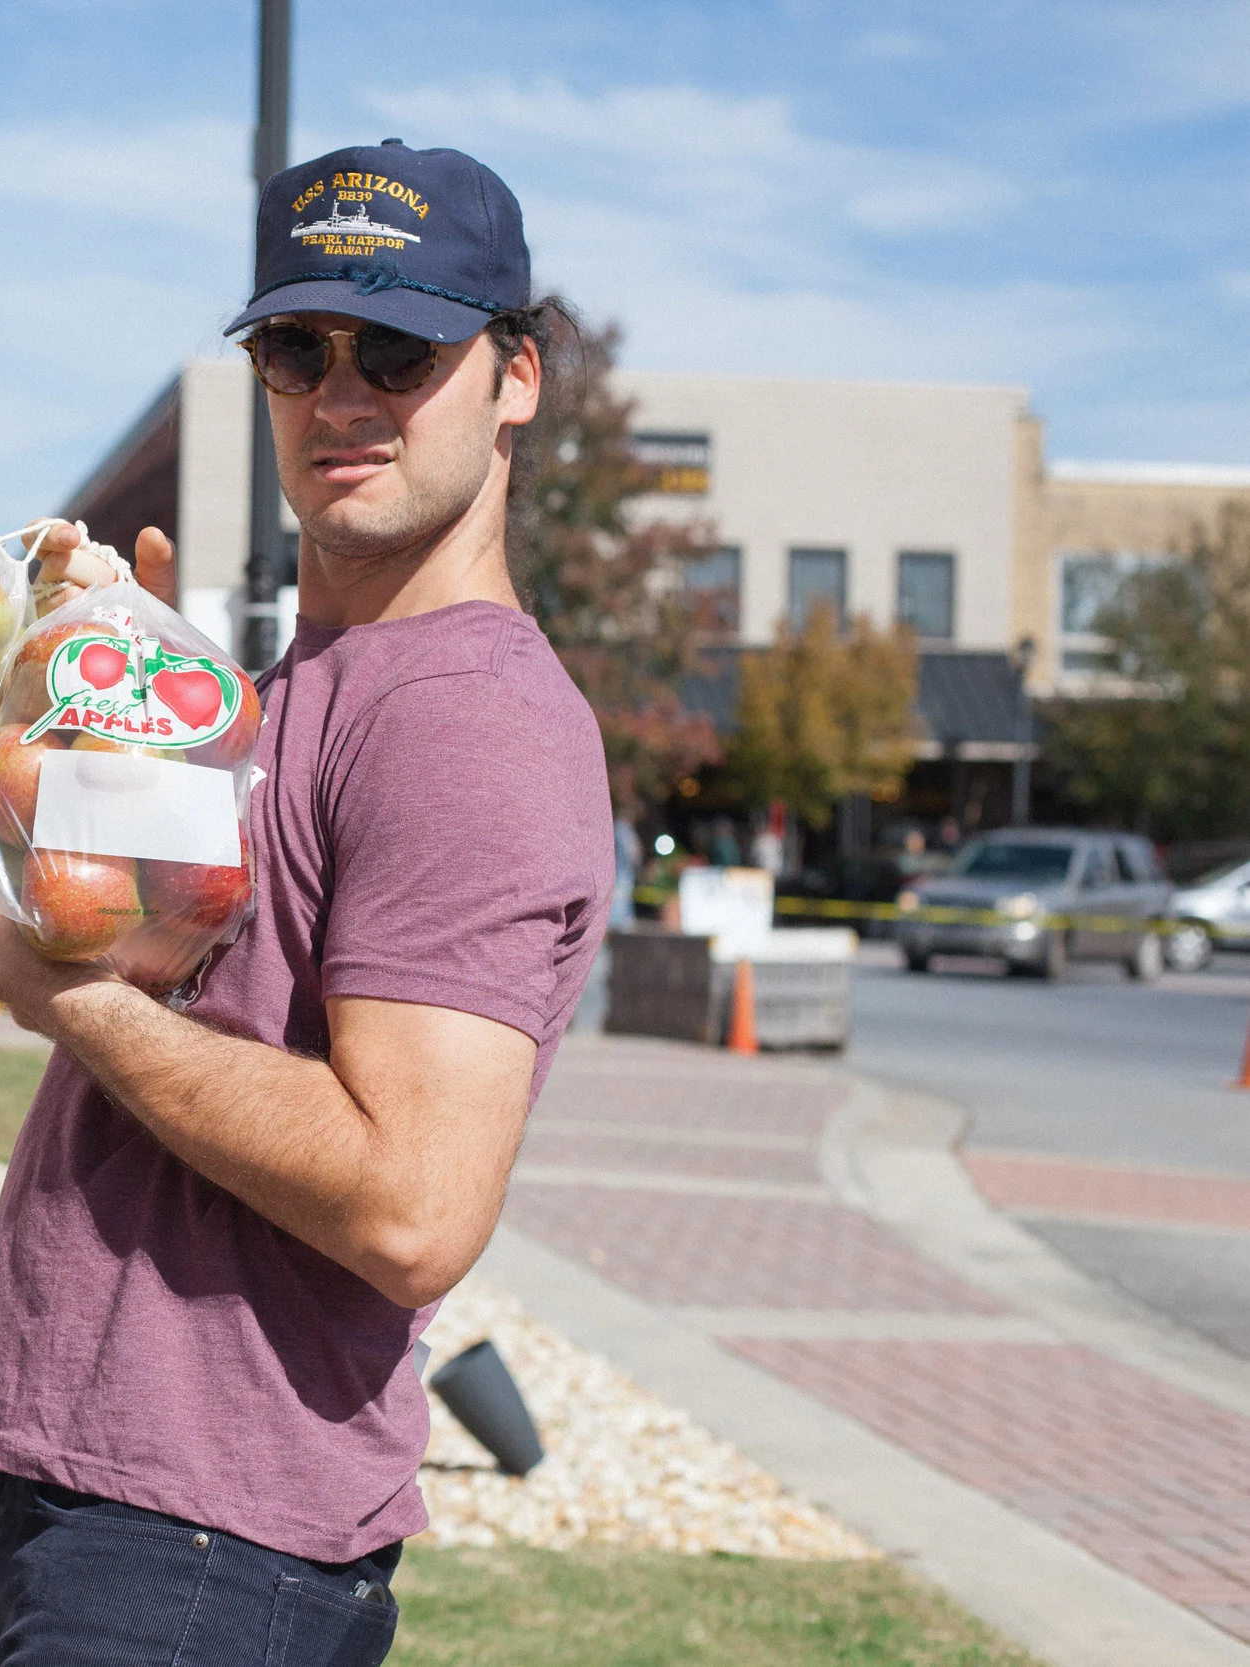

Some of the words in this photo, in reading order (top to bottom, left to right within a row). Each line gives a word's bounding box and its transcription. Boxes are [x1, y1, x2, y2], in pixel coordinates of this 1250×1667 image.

[291, 179, 325, 213] USS
[331, 172, 430, 220] ARIZONA
[337, 190, 373, 202] BB39
[302, 235, 343, 246] PEARL
[345, 235, 405, 249] HARBOR
[323, 245, 374, 256] HAWAII
[57, 707, 173, 736] APPLES
[97, 907, 130, 915] PRODUCE
